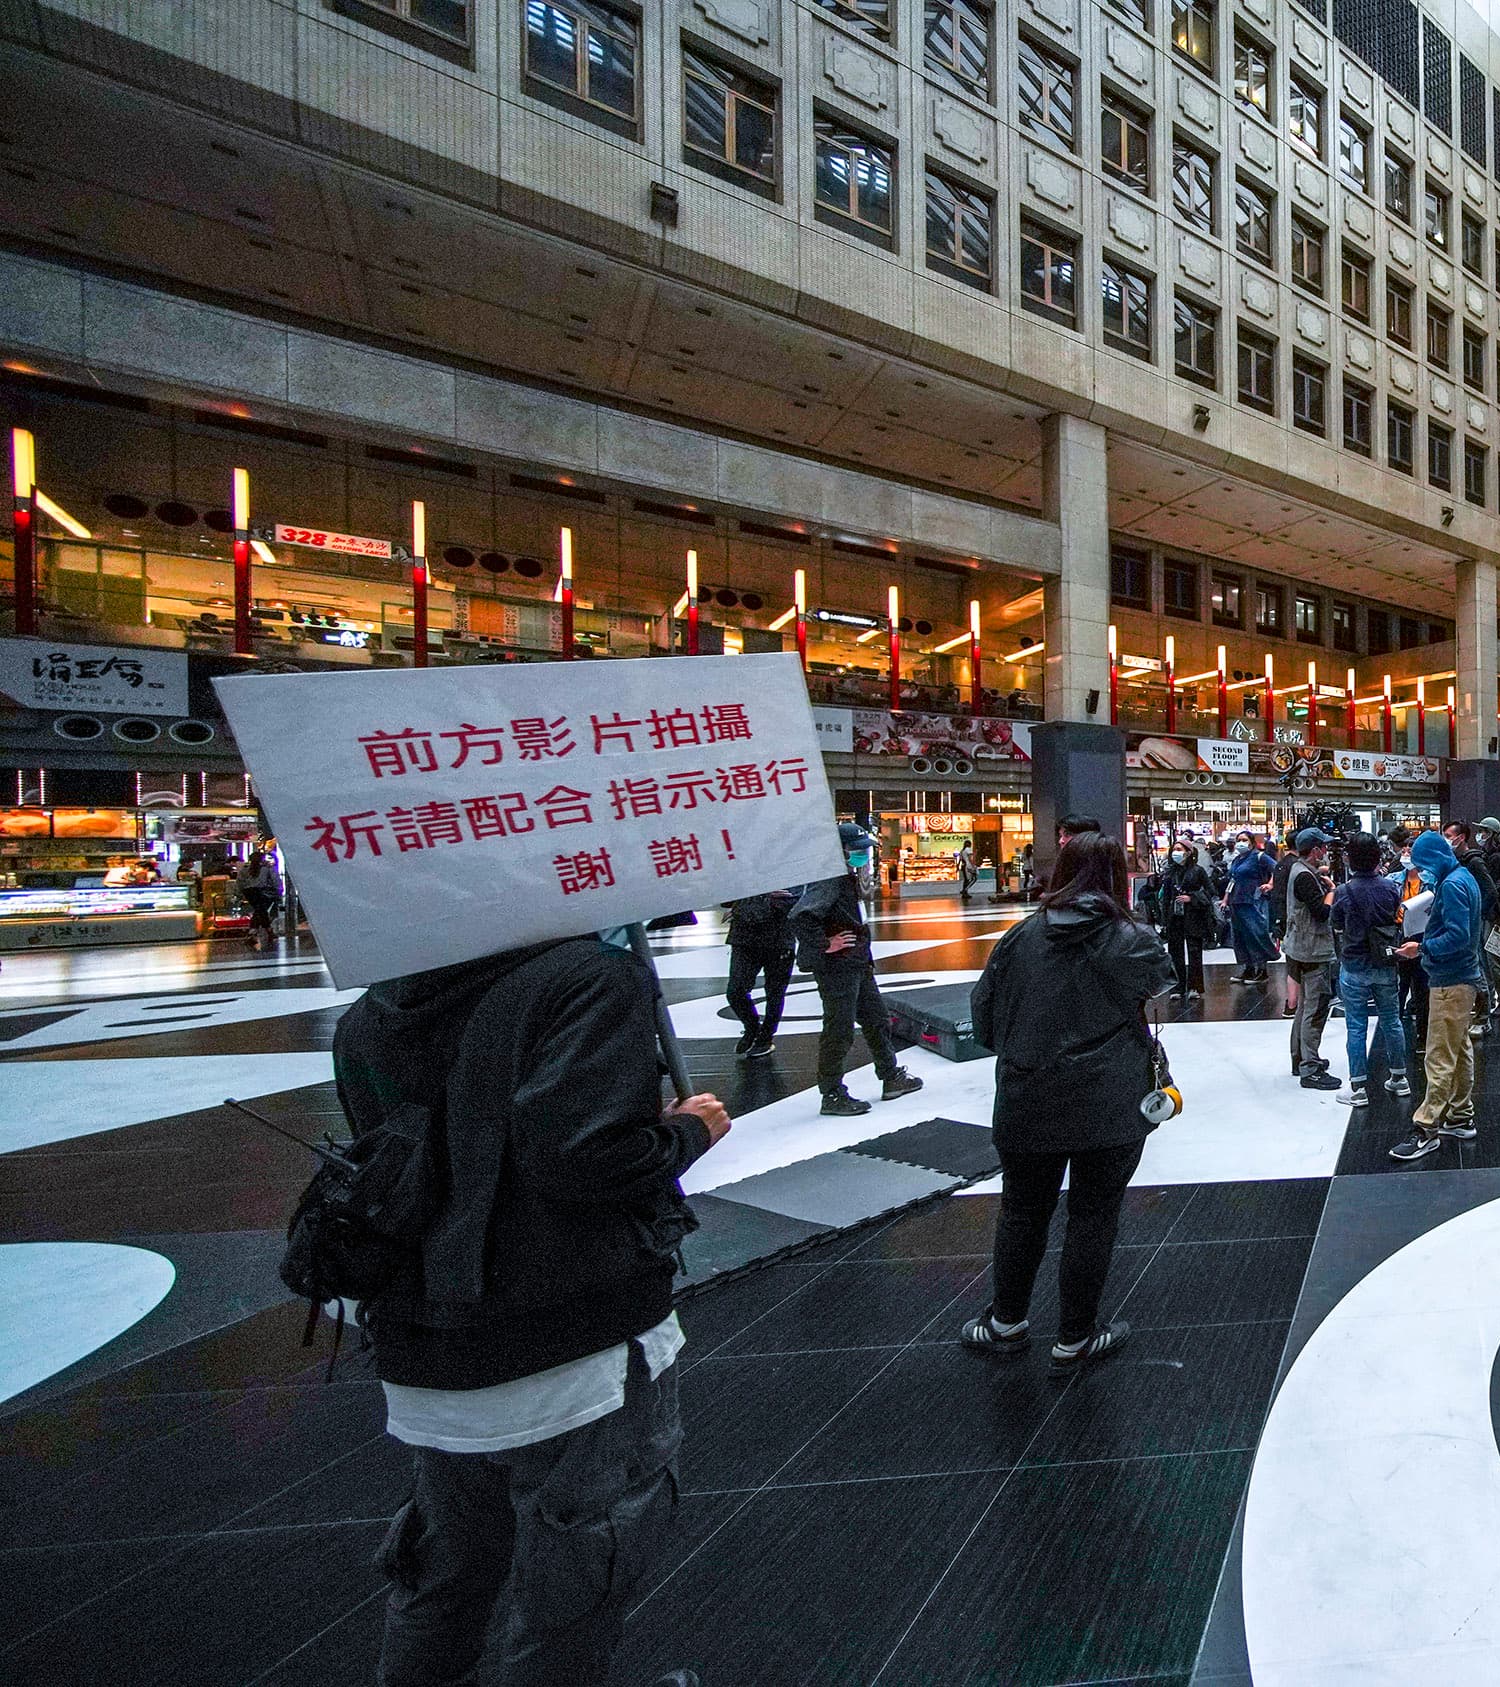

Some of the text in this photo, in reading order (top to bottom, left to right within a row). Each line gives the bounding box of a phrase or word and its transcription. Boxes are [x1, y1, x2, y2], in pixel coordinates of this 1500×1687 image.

[281, 528, 327, 547] 328
[357, 703, 753, 778] 前方影片拍攝
[1212, 746, 1243, 754] SECOND
[304, 757, 809, 864] 祈請配合指示通行
